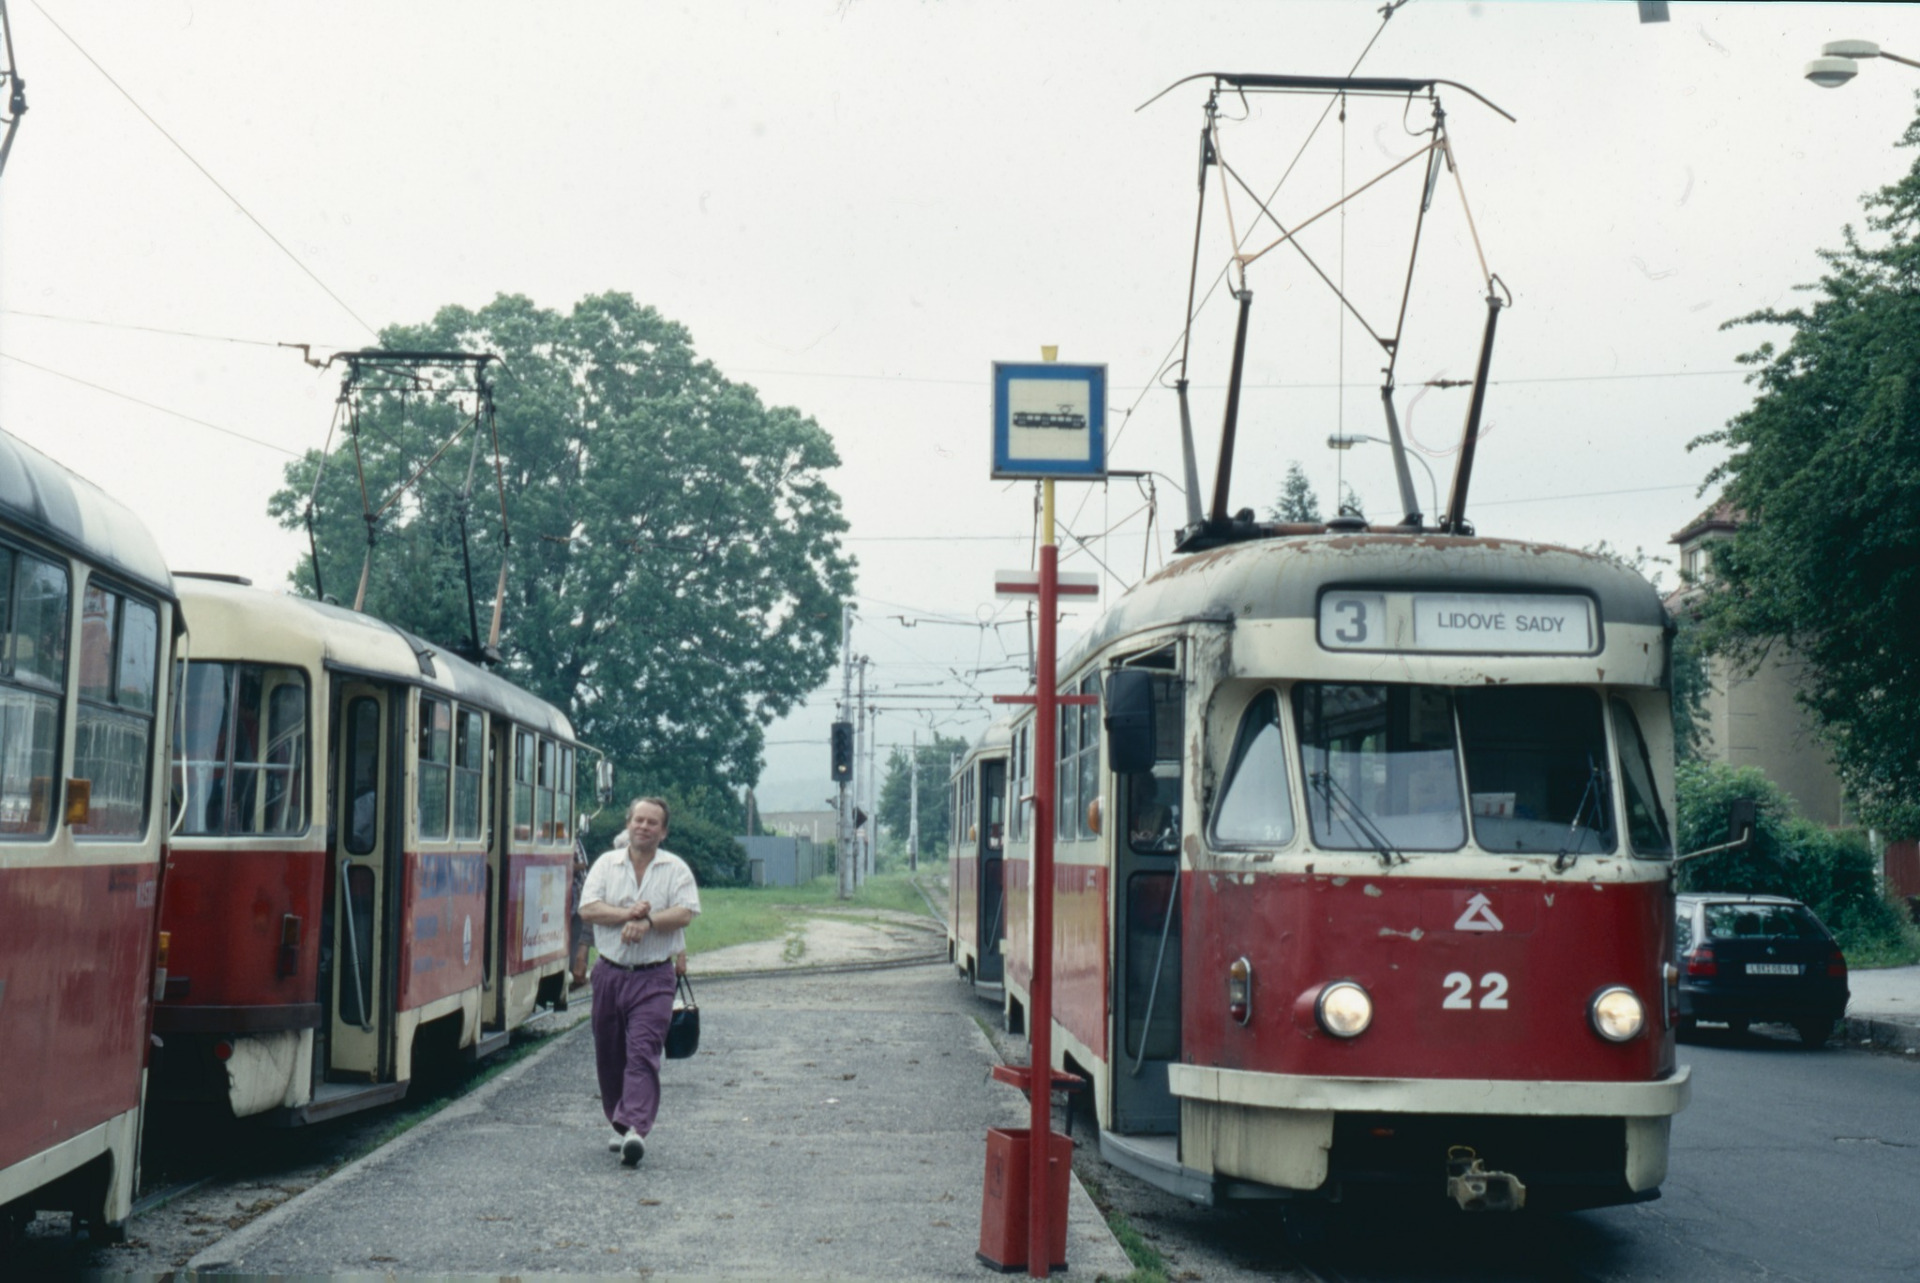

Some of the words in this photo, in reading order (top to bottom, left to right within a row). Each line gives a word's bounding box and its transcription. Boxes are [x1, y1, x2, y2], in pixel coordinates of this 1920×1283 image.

[1335, 600, 1367, 643] 3
[1438, 610, 1505, 630] LIDOVÉ
[1516, 616, 1564, 632] SADY
[1442, 971, 1508, 1009] 22
